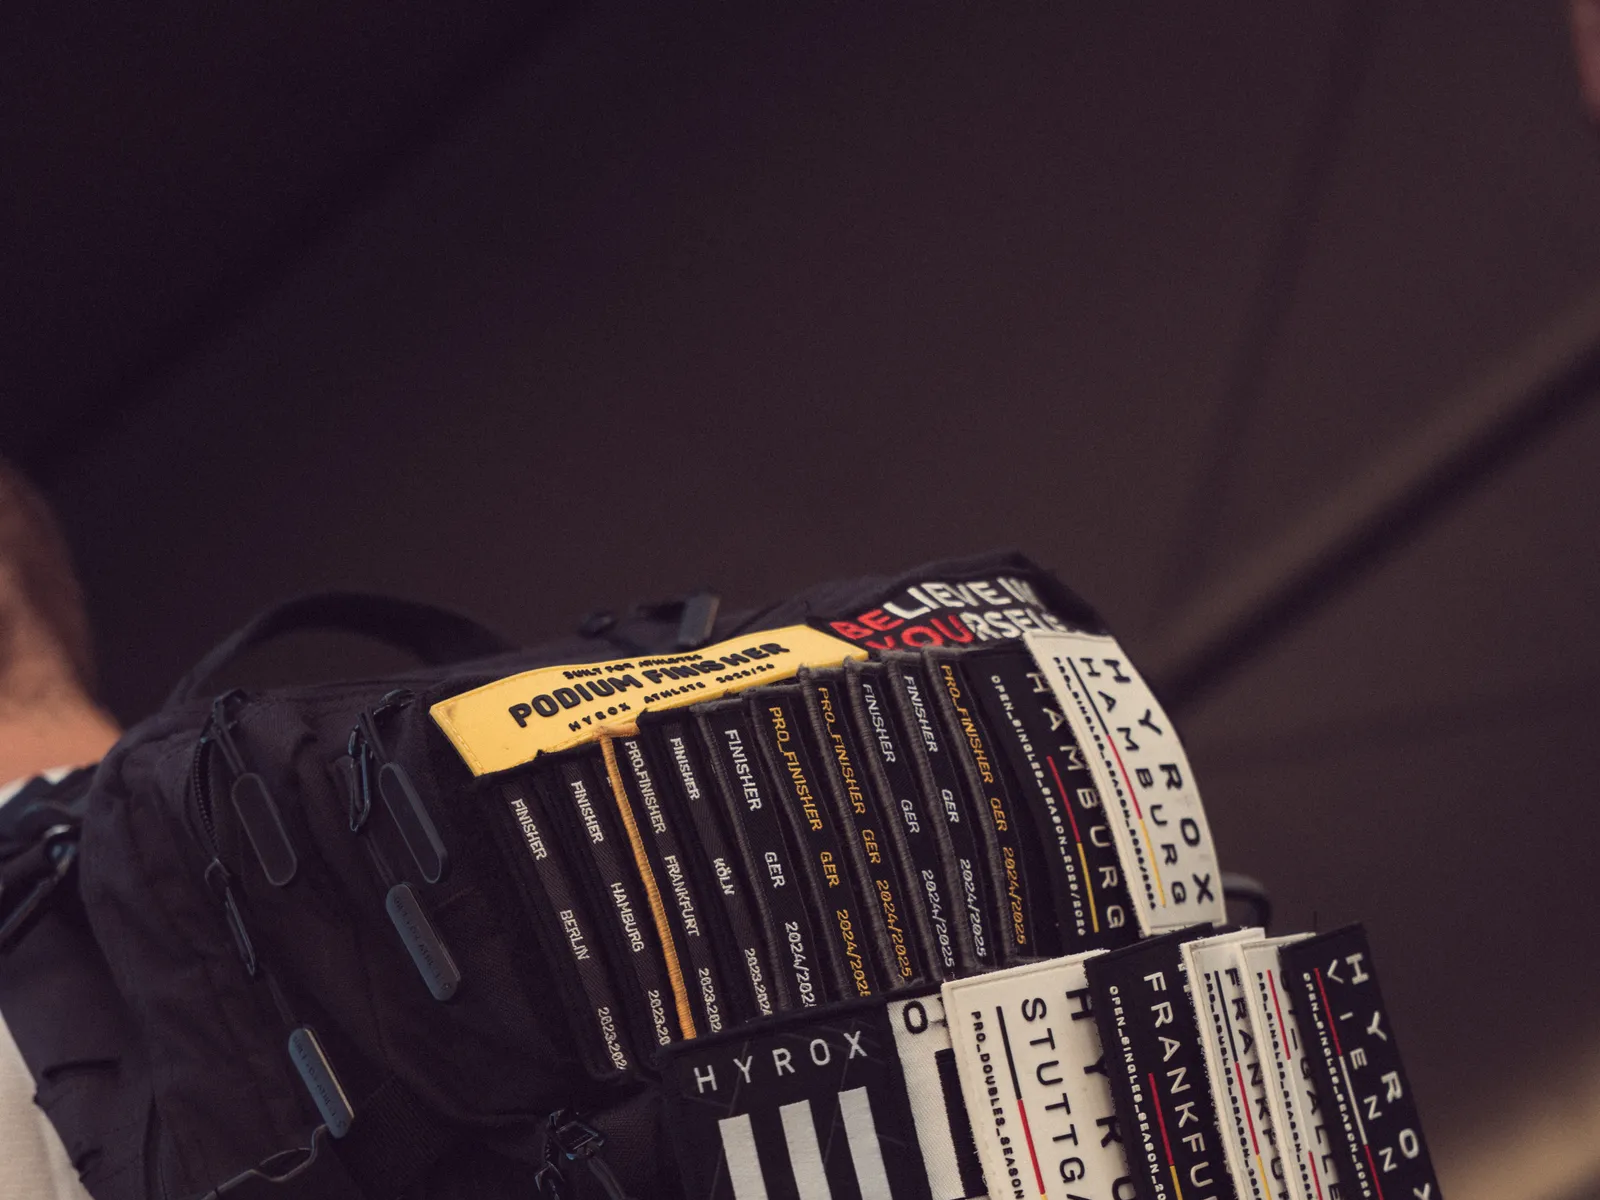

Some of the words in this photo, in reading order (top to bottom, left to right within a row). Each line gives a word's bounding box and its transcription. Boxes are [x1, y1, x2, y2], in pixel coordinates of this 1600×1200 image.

[508, 674, 644, 728] PODIUM
[641, 643, 790, 684] FINISHER
[562, 667, 602, 680] BUILT
[604, 663, 635, 673] FOR
[828, 579, 1013, 640] BELIEVE
[568, 702, 631, 732] HYROX
[769, 707, 823, 831] PRO_FINISHER
[820, 852, 840, 888] GER
[941, 665, 993, 783] PRO_FINISHER
[990, 798, 1008, 831] GER
[1003, 847, 1026, 944] 2024/2025
[1025, 670, 1127, 929] HAMBURG
[1080, 657, 1187, 905] HAMBURG
[1103, 659, 1215, 905] HYROX
[571, 780, 604, 844] FINISHER
[610, 882, 644, 952] HAMBURG
[670, 737, 700, 800] FINISHER
[713, 858, 735, 895] KÖLN
[725, 729, 762, 811] FINISHER
[765, 852, 785, 888] GER
[818, 687, 866, 814] PRO_FINISHER
[862, 829, 881, 863] GER
[876, 880, 912, 977] 2024/2025
[863, 684, 896, 762] FINISHER
[901, 799, 920, 833] GER
[921, 869, 955, 967] 2024/2025
[904, 676, 938, 752] FINISHER
[941, 789, 959, 823] GER
[960, 859, 987, 956] 2024/2025
[511, 798, 547, 860] FINISHER
[560, 910, 590, 960] BERLIN
[598, 1007, 627, 1070] 2023.202
[664, 855, 700, 936] FRANKFURT
[698, 968, 722, 1033] 2023.202
[693, 1030, 868, 1094] HYROX
